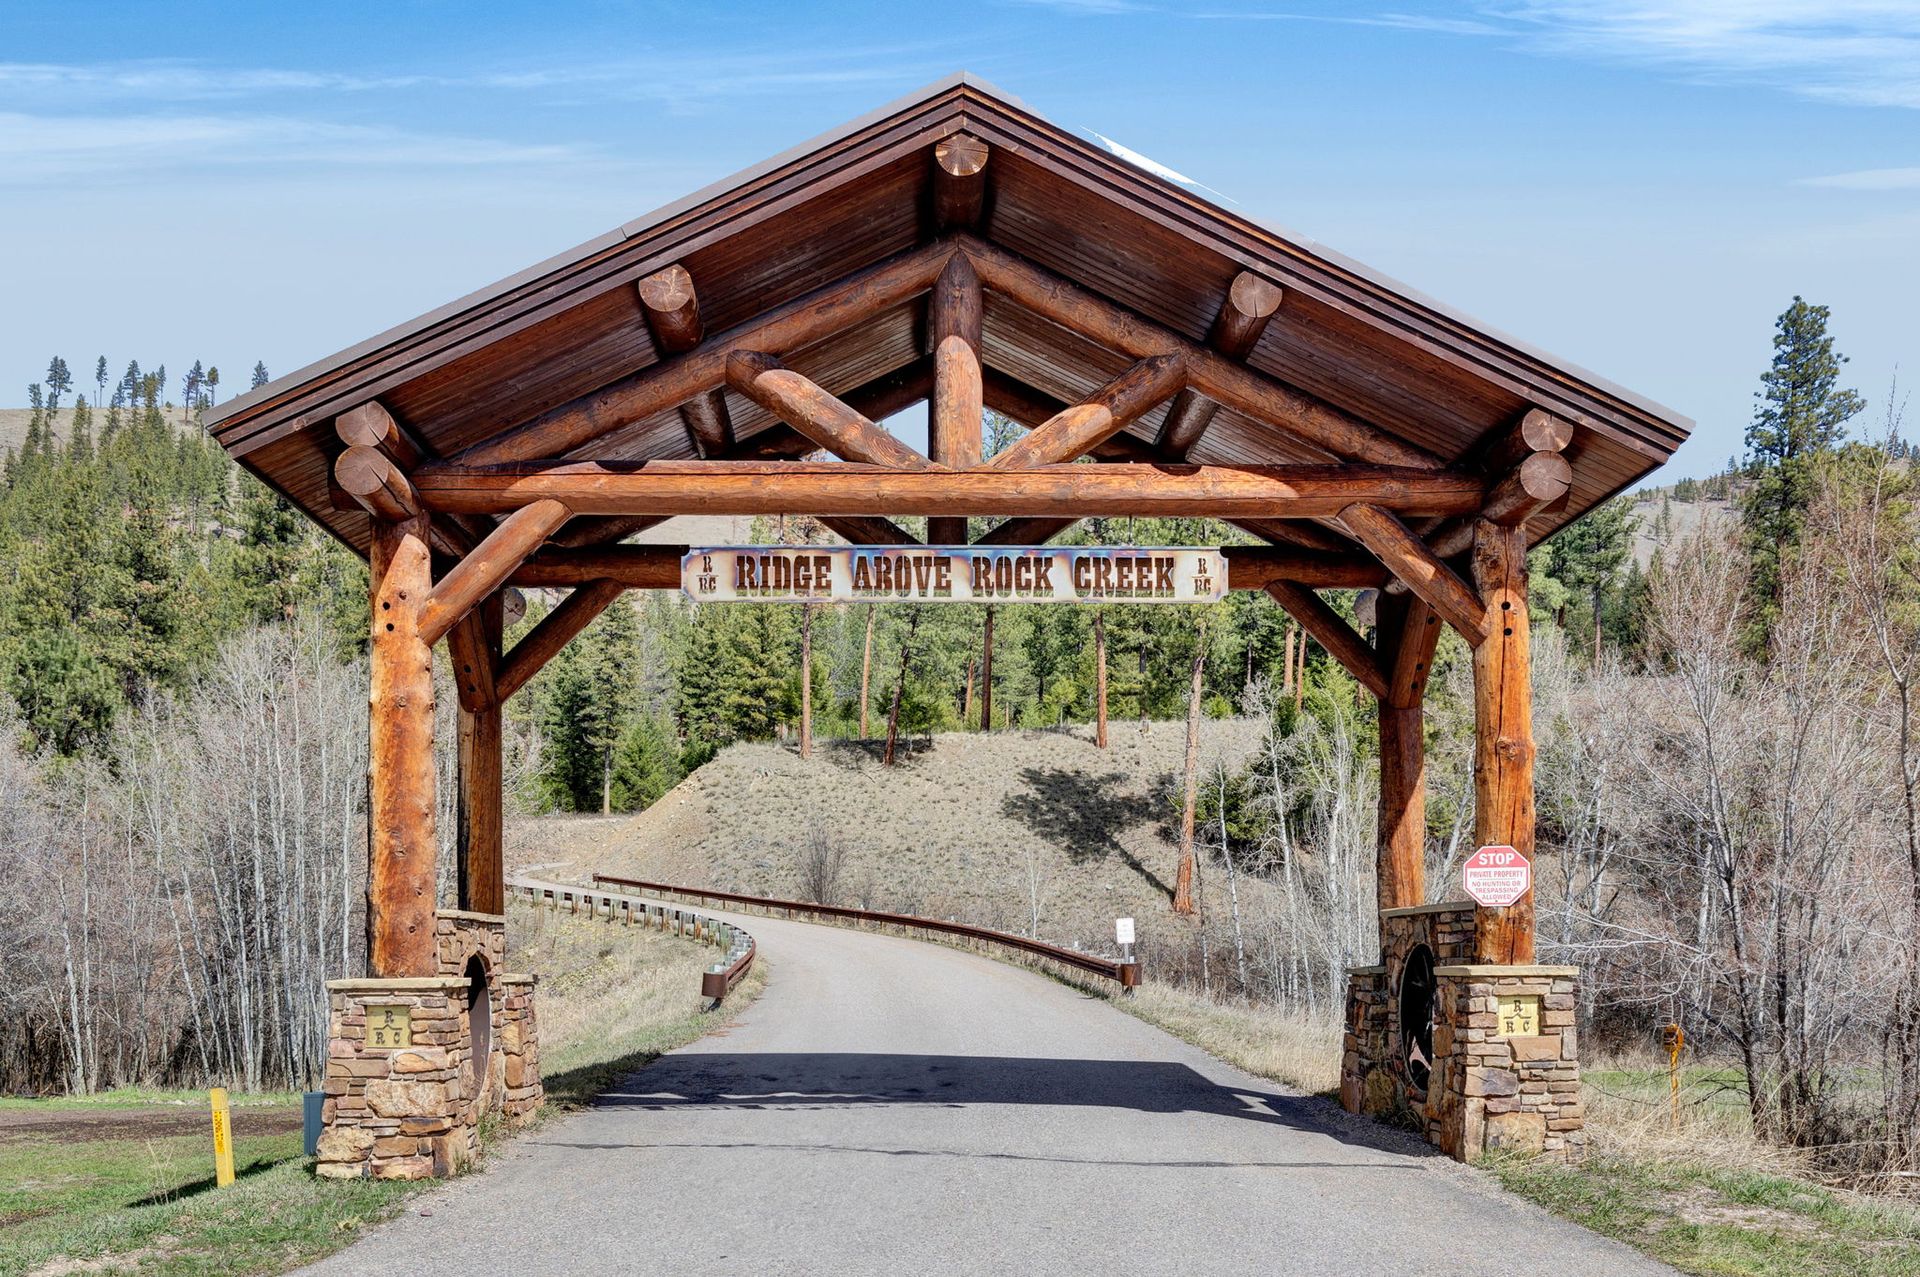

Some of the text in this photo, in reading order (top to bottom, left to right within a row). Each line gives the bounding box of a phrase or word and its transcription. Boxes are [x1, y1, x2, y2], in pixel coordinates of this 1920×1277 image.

[736, 555, 1176, 598] RIDGE ABOVE ROCK CREEK
[1478, 853, 1515, 865] STOP
